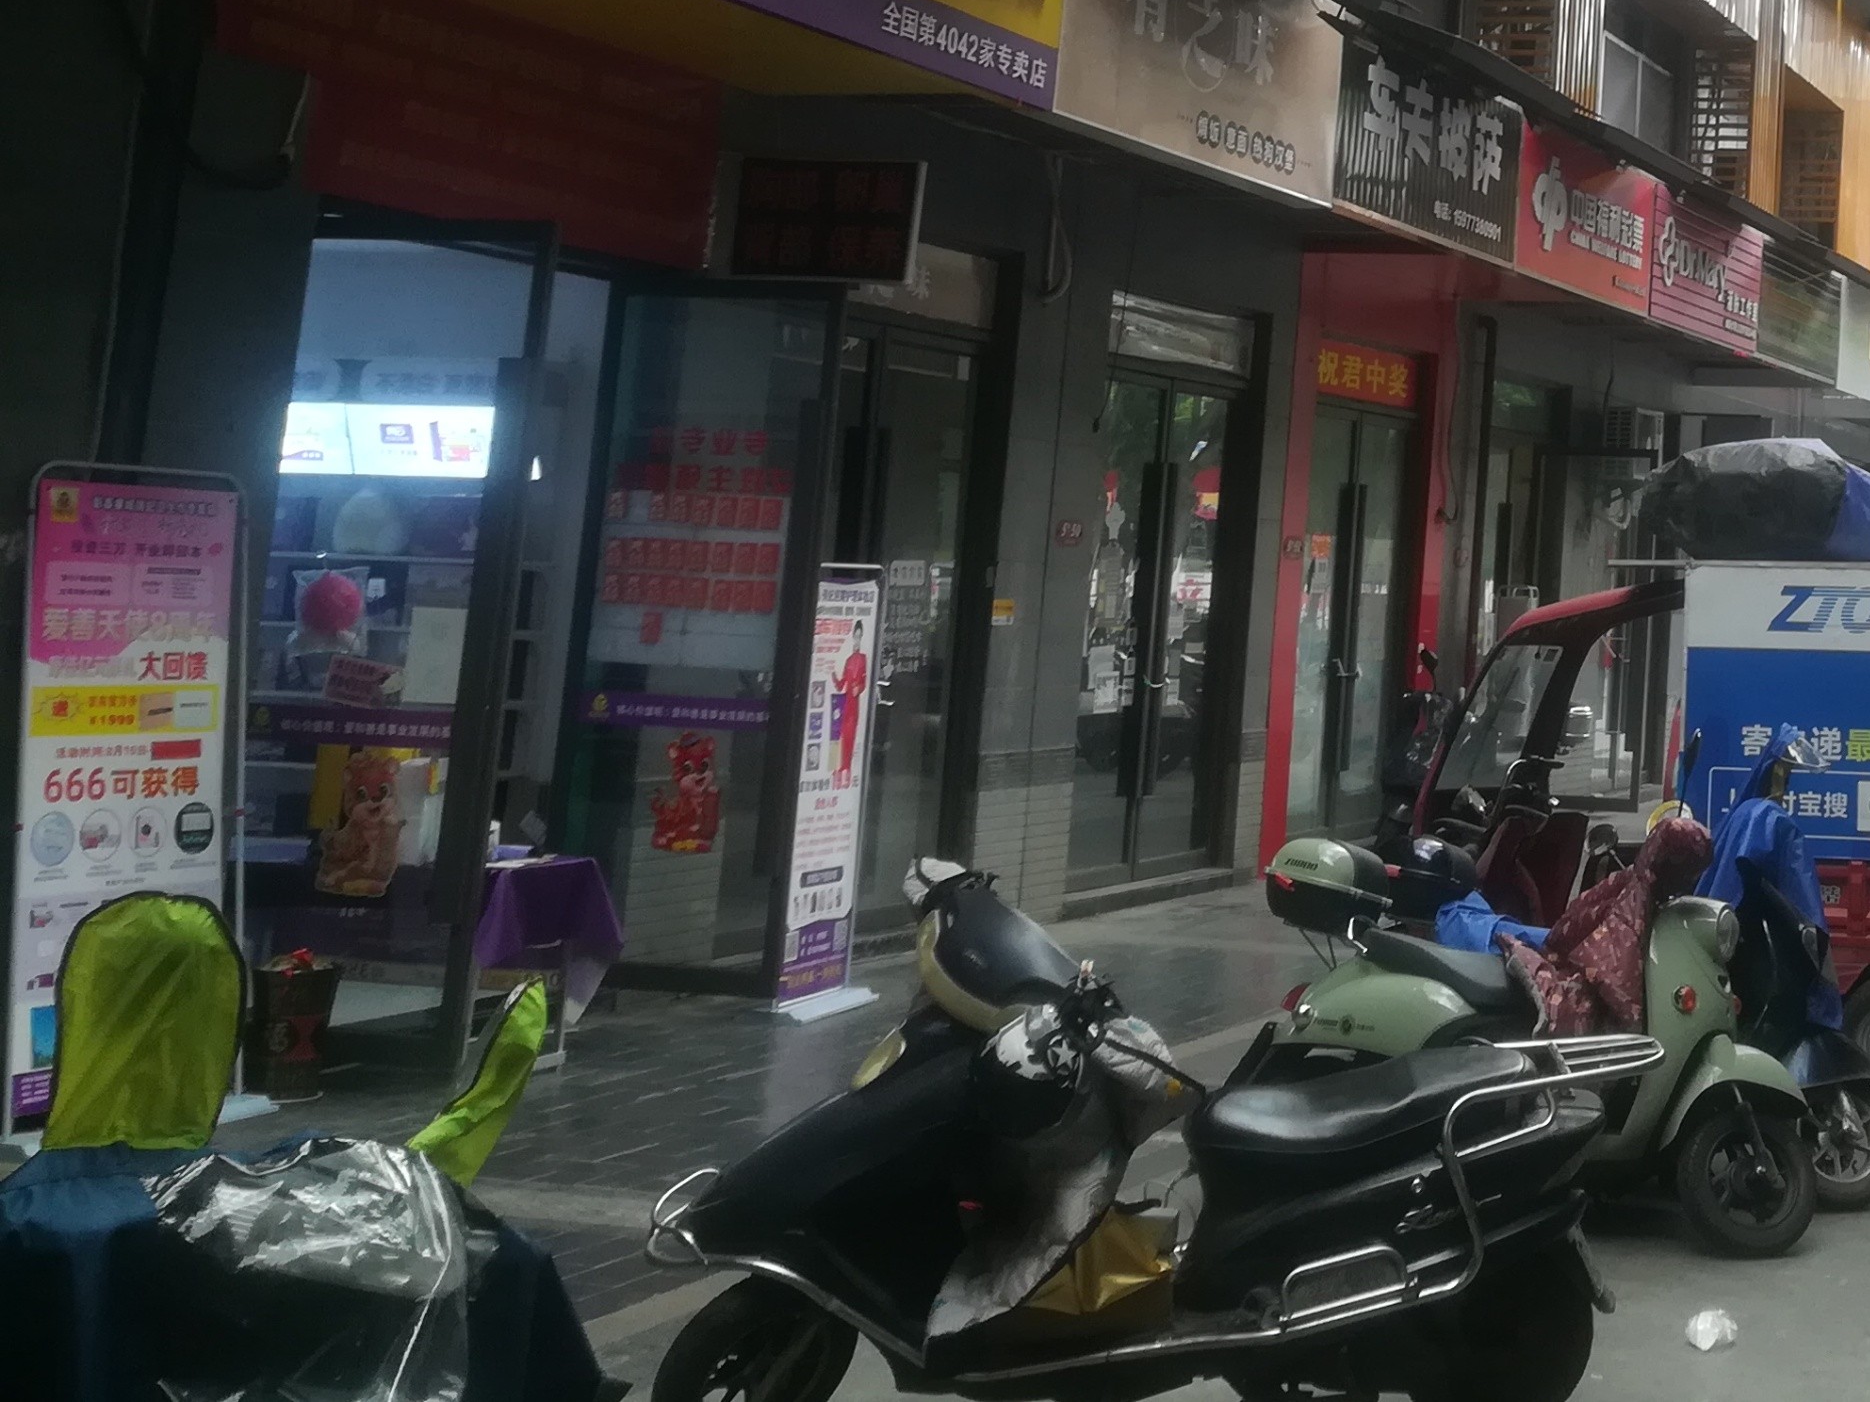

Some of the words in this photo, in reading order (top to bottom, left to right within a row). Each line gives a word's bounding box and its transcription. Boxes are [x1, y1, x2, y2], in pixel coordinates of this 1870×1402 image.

[881, 1, 1049, 89] 全国第4042家专卖店
[1570, 189, 1645, 254] 中国福利彩票
[1317, 348, 1409, 398] 祝君中奖
[139, 651, 208, 681] 大回馈
[44, 766, 200, 803] 666可获得
